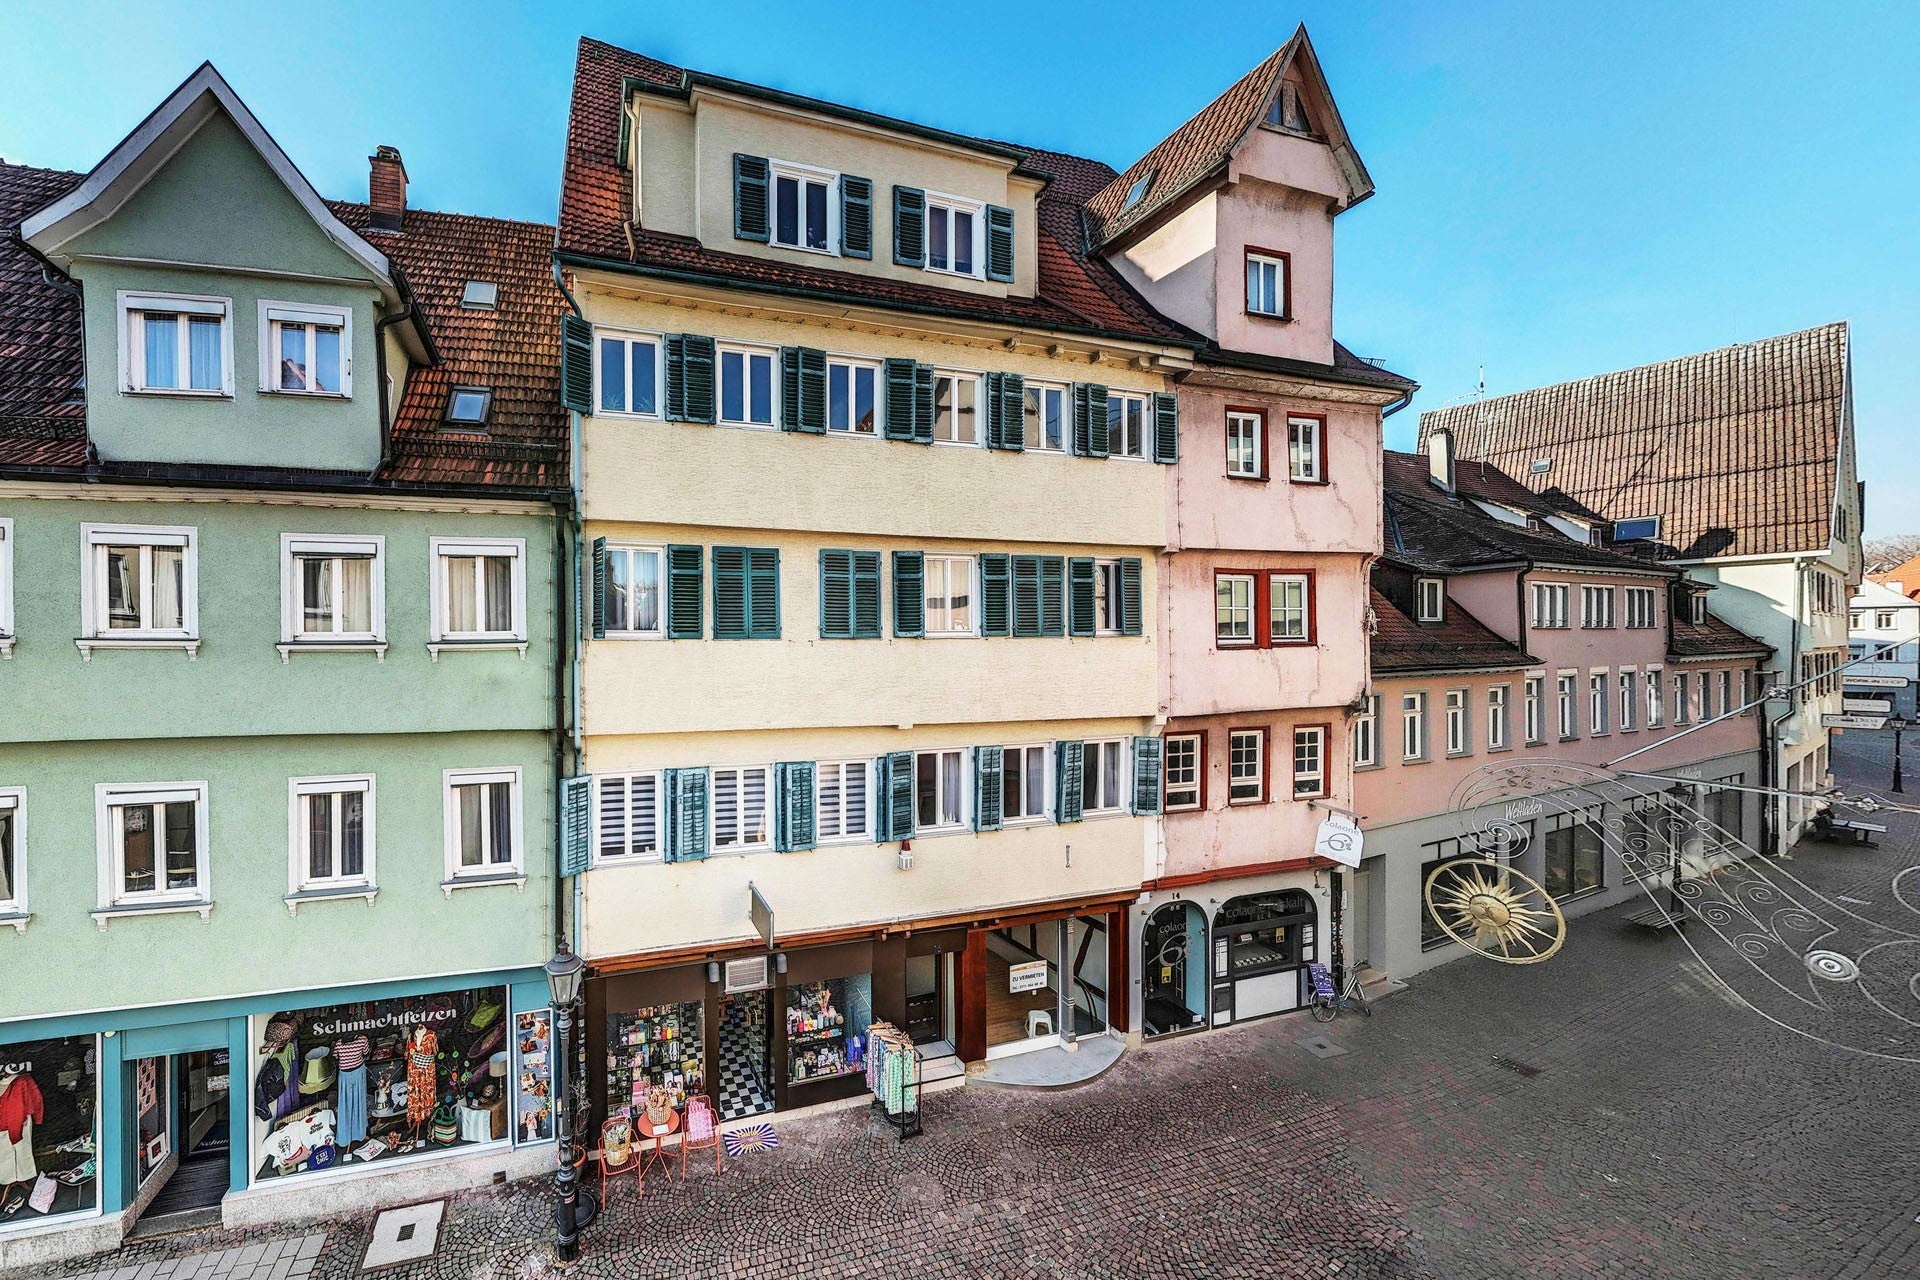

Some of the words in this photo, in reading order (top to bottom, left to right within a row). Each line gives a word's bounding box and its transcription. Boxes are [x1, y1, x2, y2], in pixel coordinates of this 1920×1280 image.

[1505, 799, 1543, 819] Weltladen
[1324, 820, 1360, 836] colaone
[1172, 892, 1180, 900] 14
[1019, 972, 1045, 981] VERMIETEN
[312, 1008, 457, 1036] Schmachtfetzen
